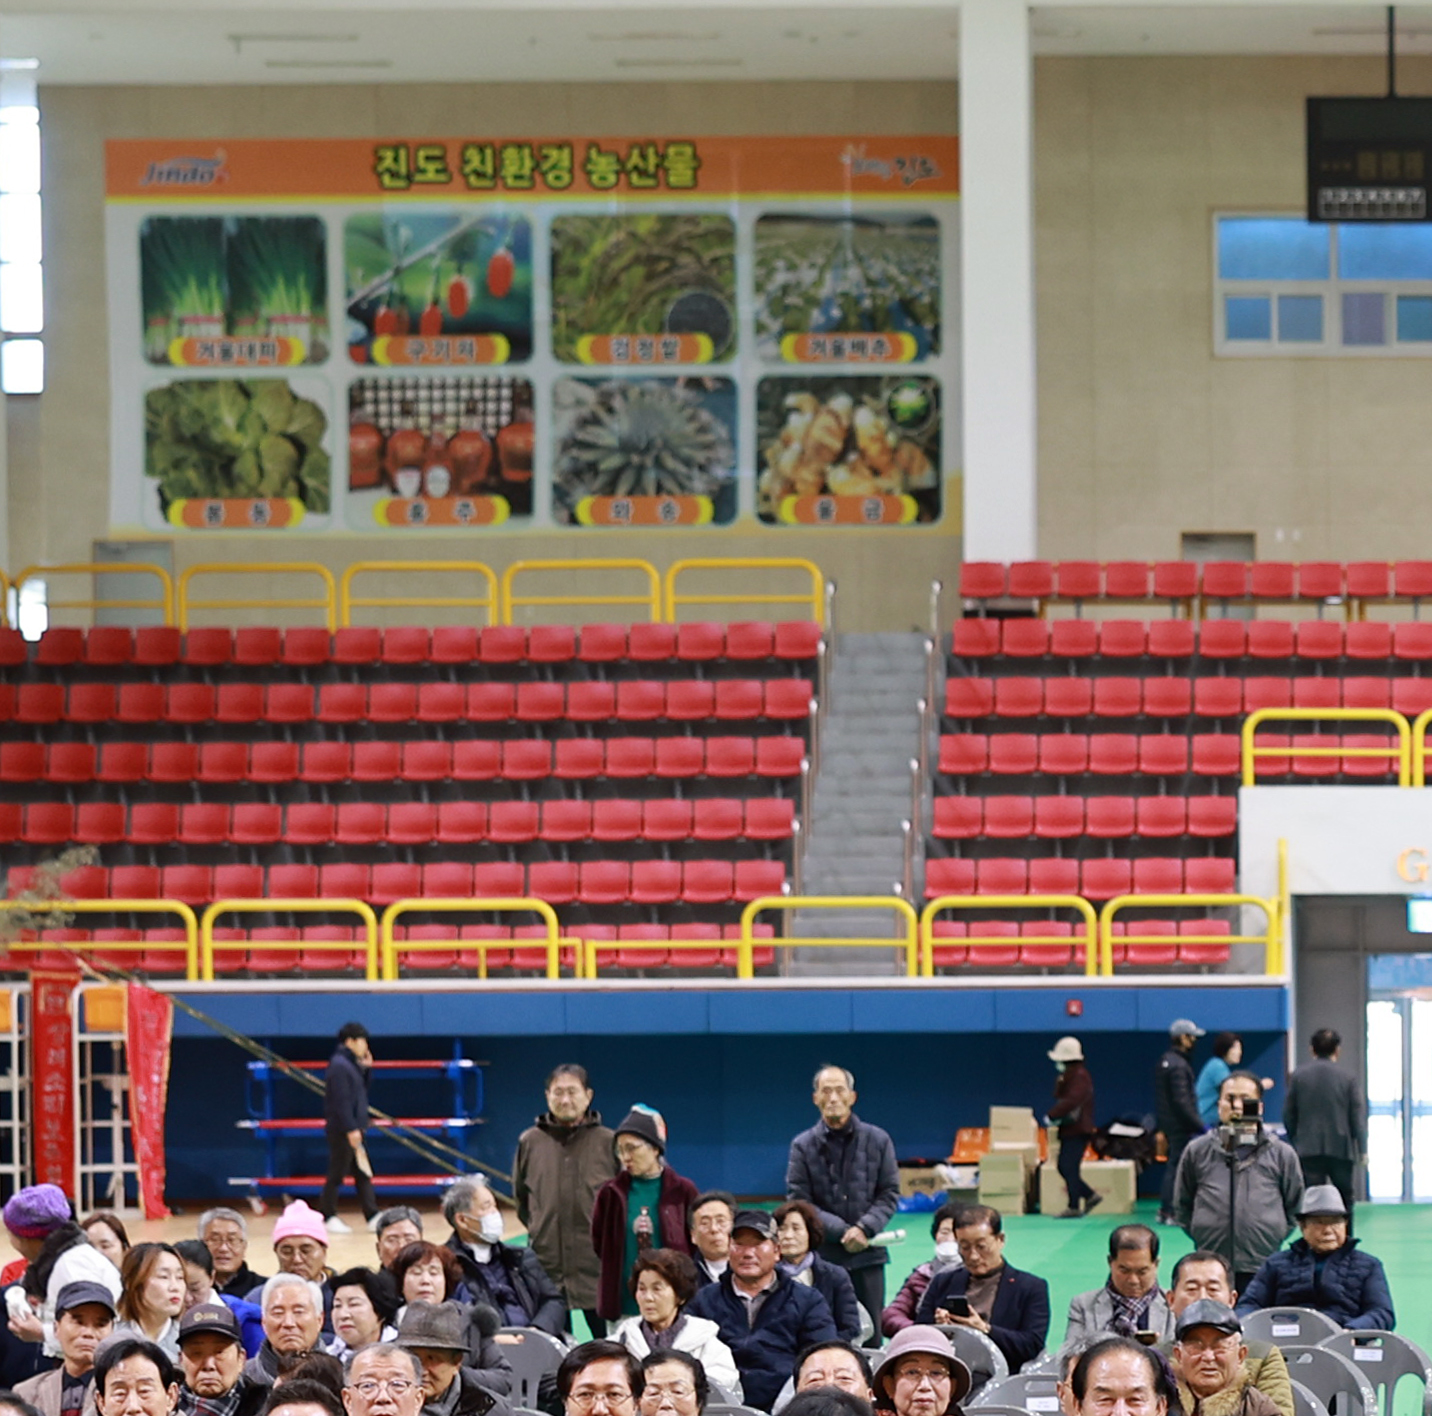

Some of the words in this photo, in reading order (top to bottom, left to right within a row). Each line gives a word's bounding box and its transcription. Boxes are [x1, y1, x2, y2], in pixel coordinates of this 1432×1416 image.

[375, 143, 451, 189] 진도
[462, 142, 573, 190] 친환경
[585, 142, 700, 190] 농산물
